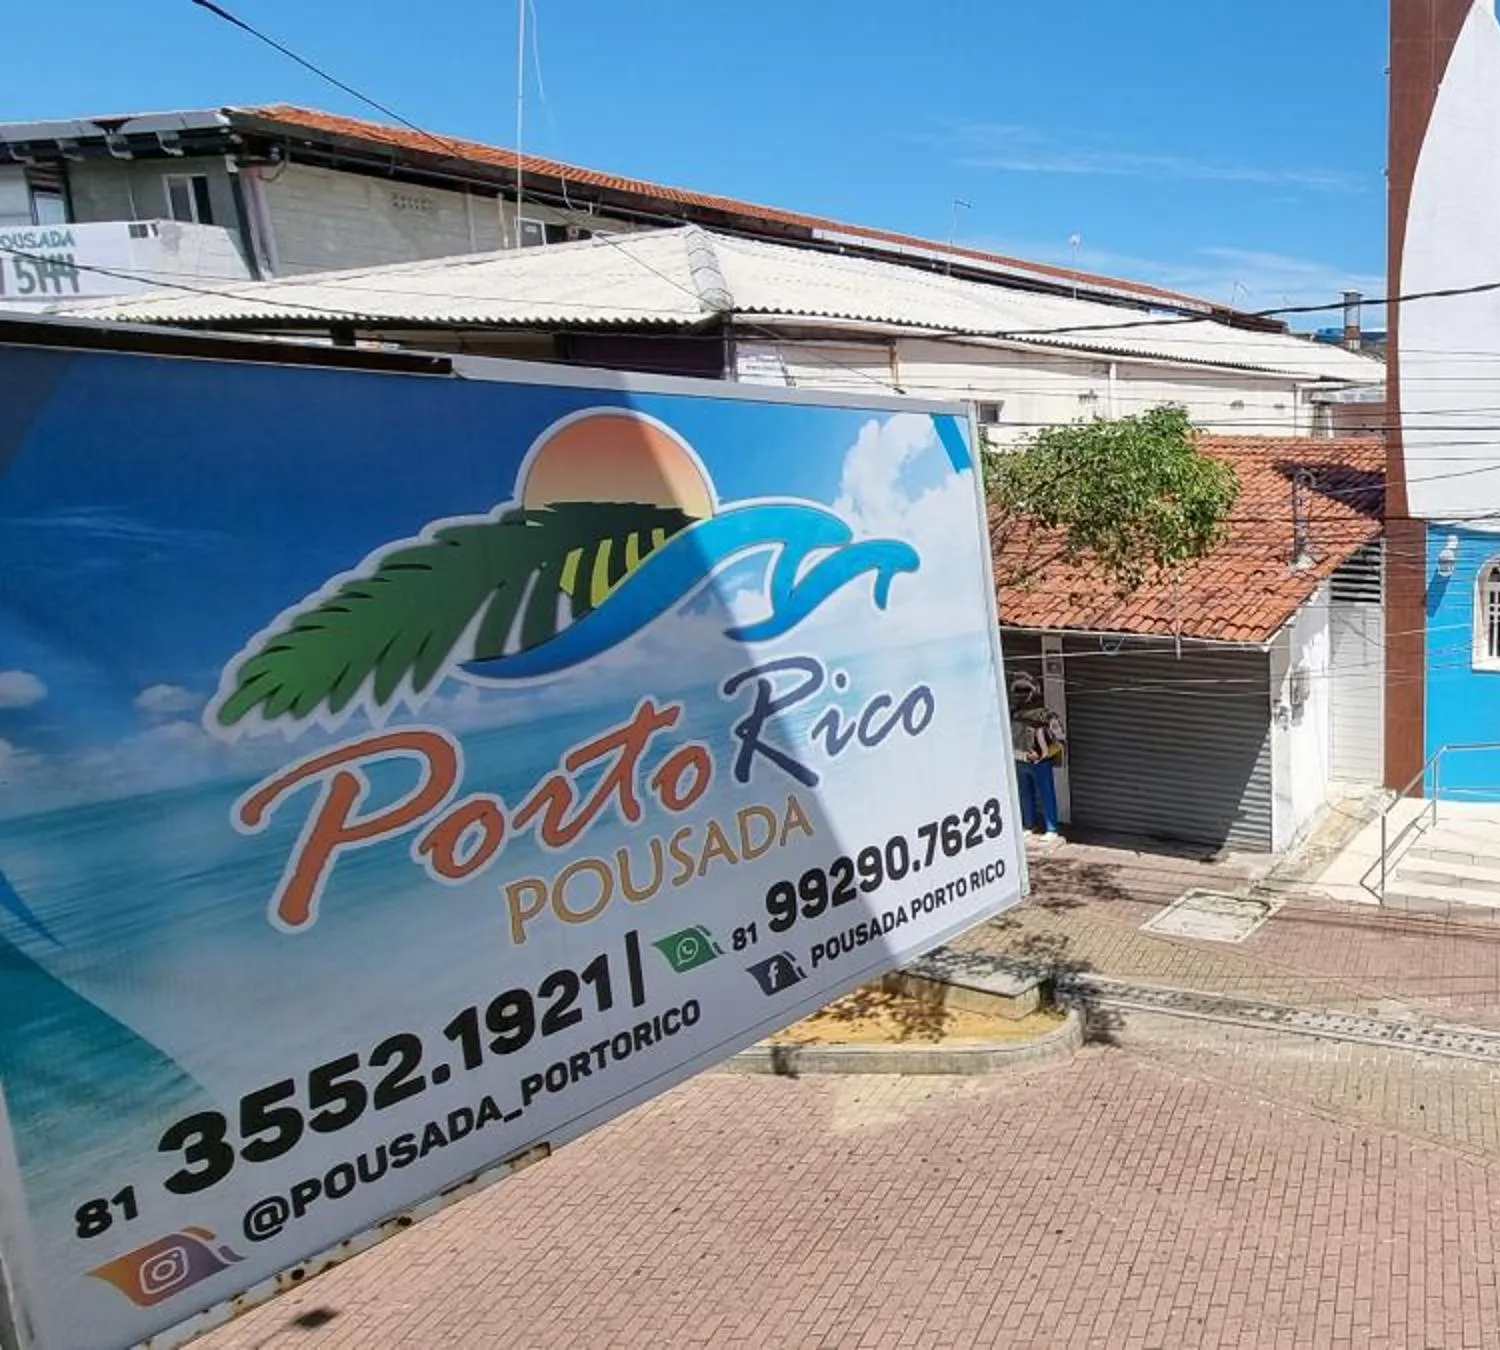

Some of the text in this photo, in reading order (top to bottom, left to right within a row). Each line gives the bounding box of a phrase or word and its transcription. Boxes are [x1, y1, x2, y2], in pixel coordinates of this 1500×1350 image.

[239, 656, 935, 926] Porto Rico
[505, 794, 814, 944] POUSADA
[732, 798, 1003, 952] 81 99290.7623
[811, 907, 908, 968] POUSADA
[912, 877, 968, 920] PORTO
[971, 858, 1006, 890] RICO
[74, 953, 612, 1239] 81 3552.1921
[243, 1000, 701, 1241] @POUSADA_PORTORICO
